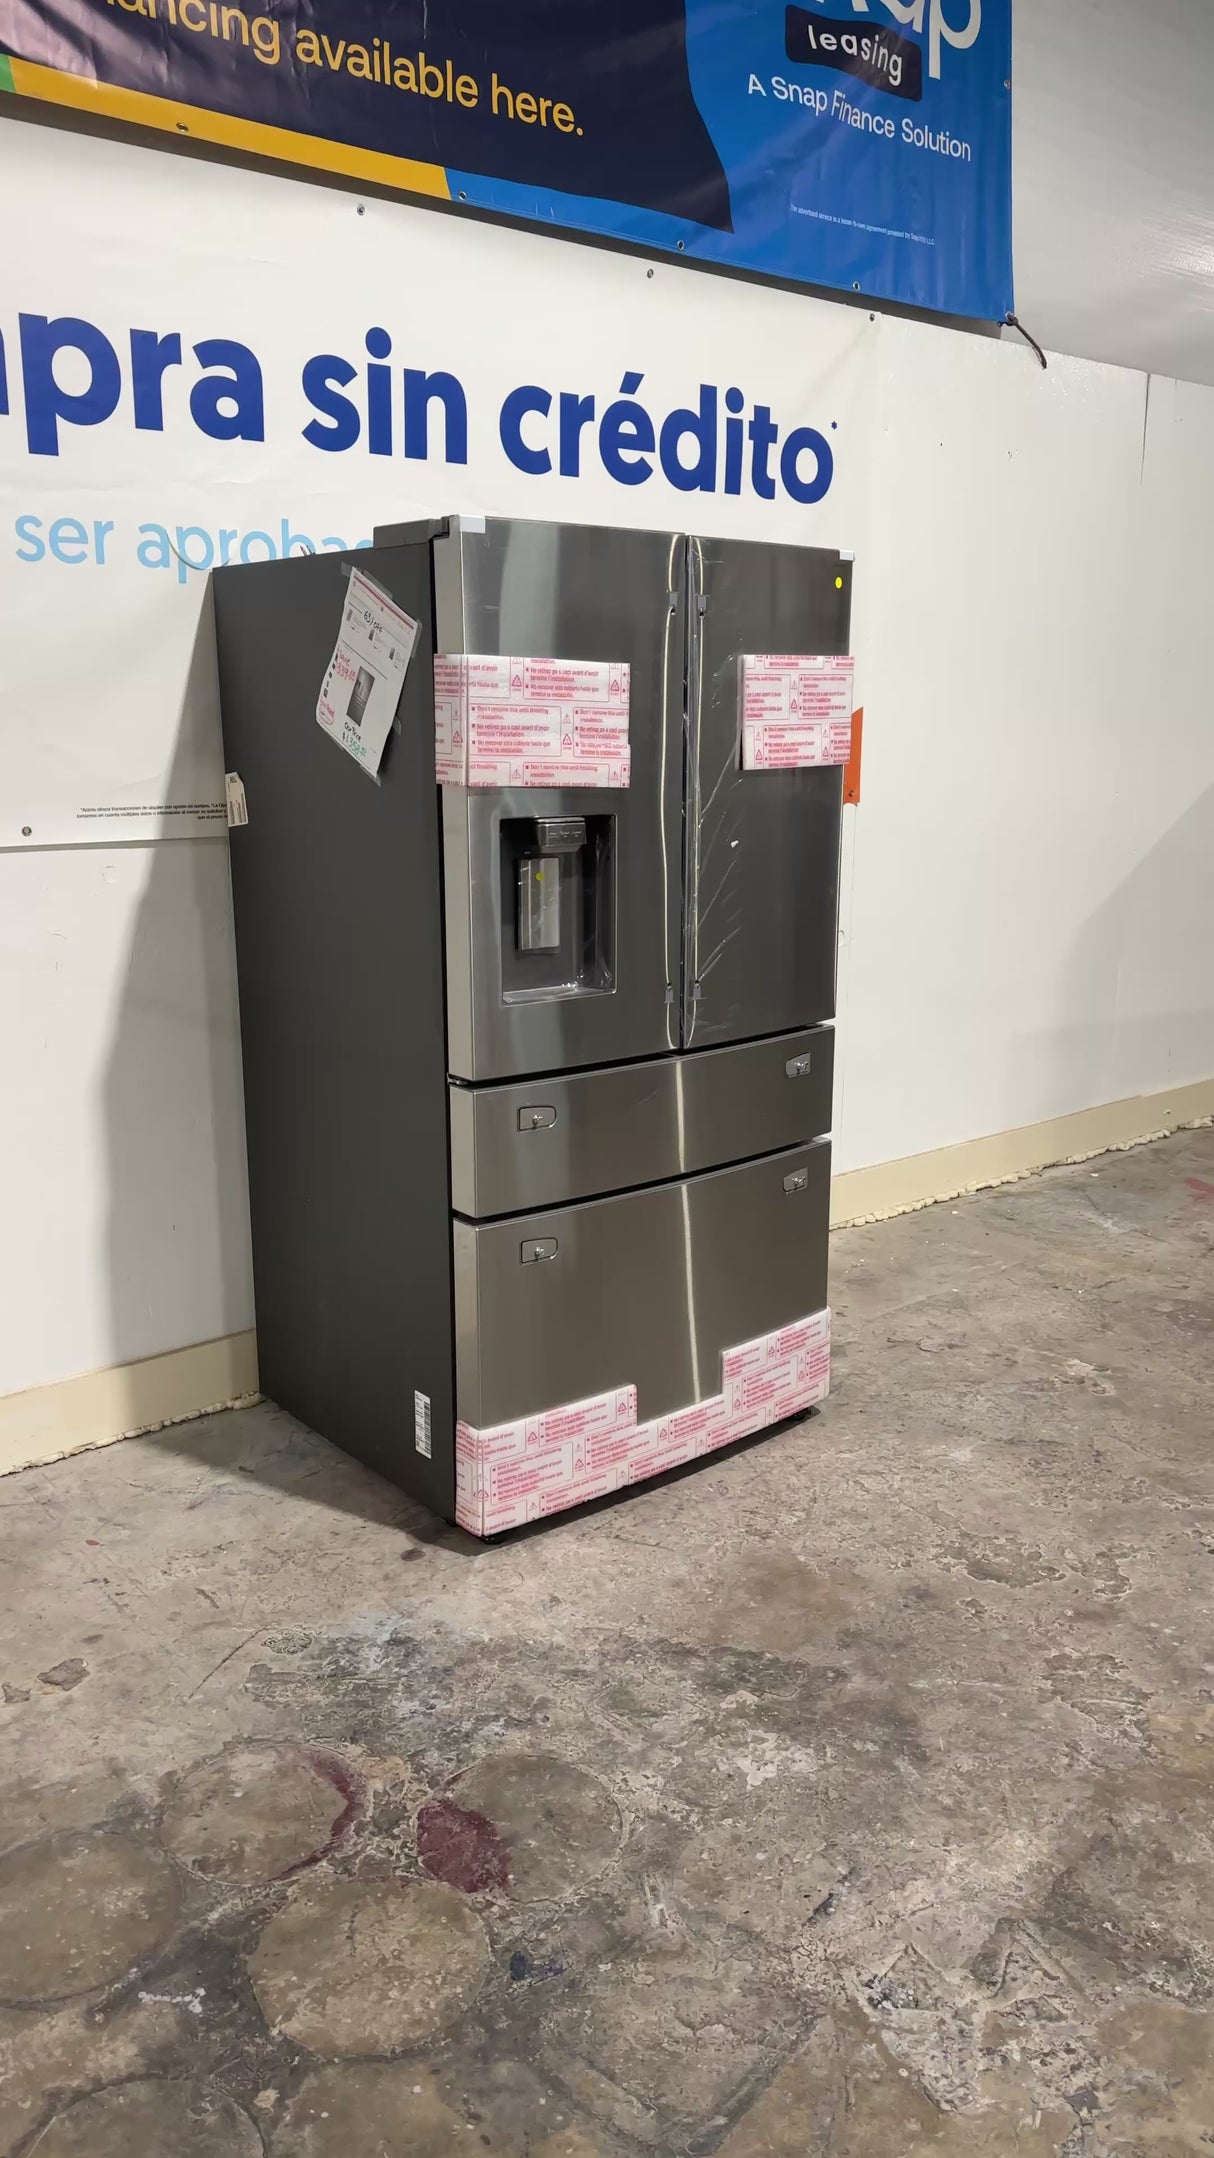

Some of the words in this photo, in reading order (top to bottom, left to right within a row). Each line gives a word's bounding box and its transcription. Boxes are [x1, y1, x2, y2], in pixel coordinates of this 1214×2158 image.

[106, 0, 281, 65] ncing
[295, 26, 479, 108] available
[490, 71, 585, 136] here.
[808, 24, 903, 87] leasing
[748, 73, 767, 97] A
[773, 76, 828, 116] Snap
[831, 89, 896, 138] Finance
[901, 118, 972, 162] Solution
[0, 312, 265, 457] pra
[301, 326, 468, 465] sin
[15, 514, 114, 565] ser
[137, 518, 374, 584] aprob
